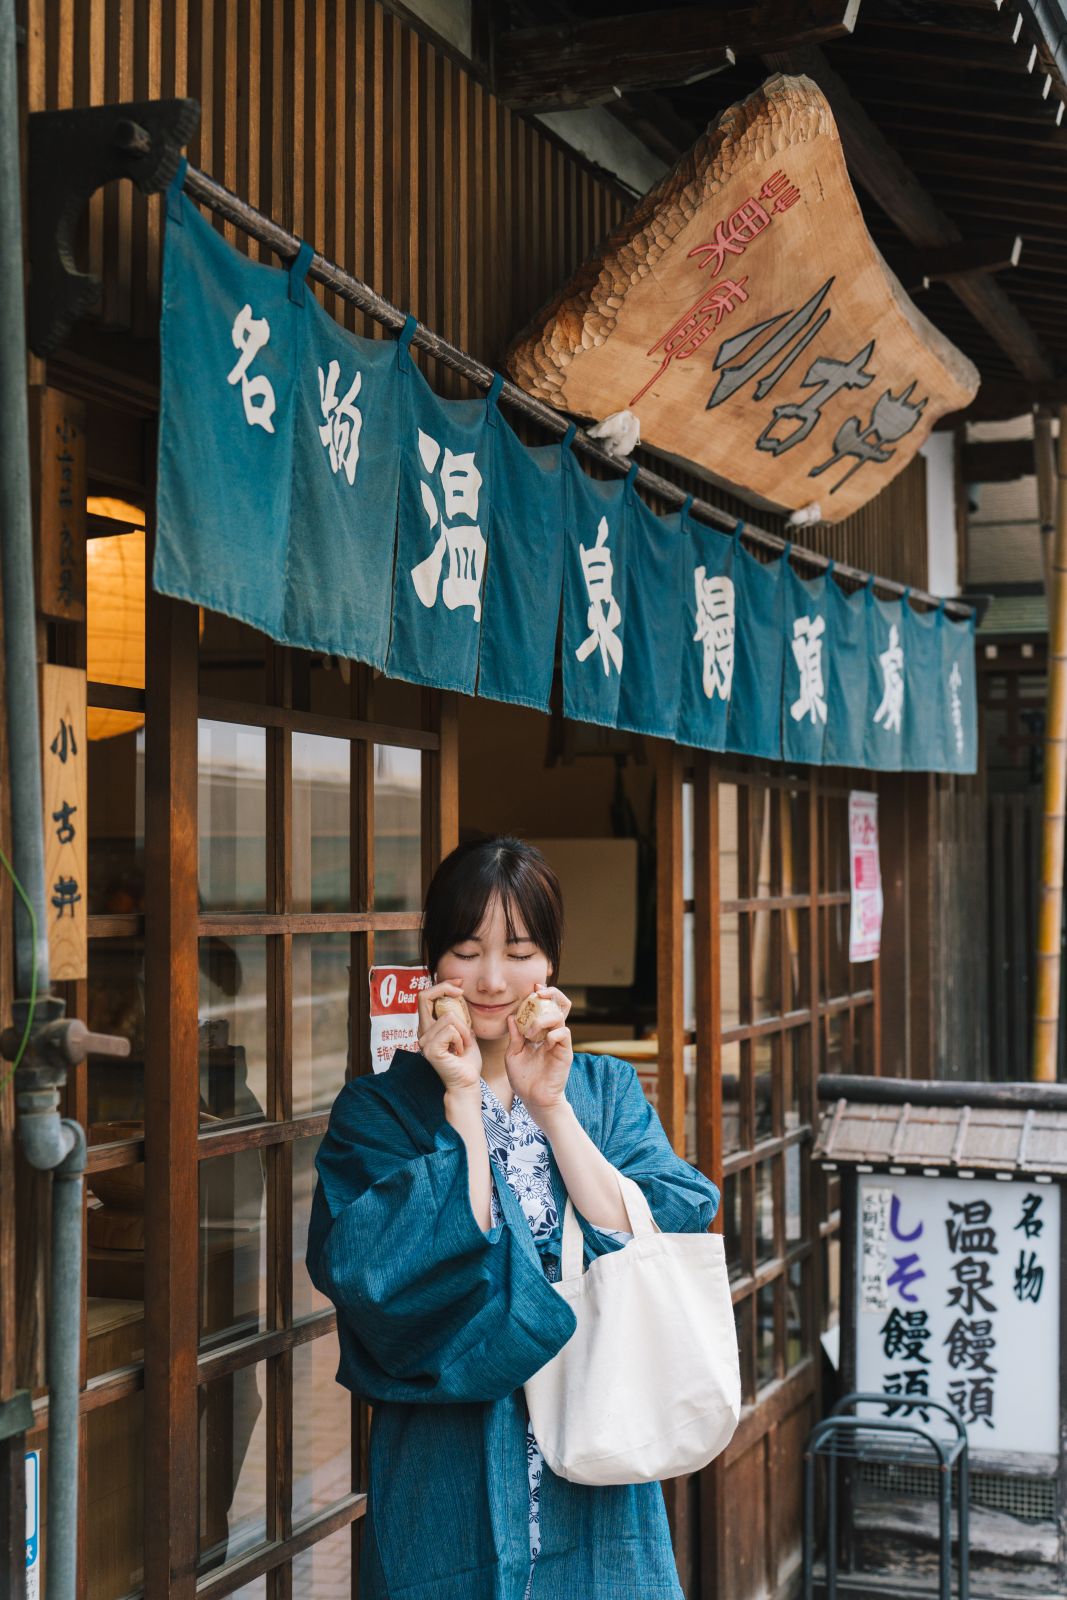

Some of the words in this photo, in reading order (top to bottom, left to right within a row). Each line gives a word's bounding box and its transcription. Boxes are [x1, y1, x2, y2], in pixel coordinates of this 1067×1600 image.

[706, 275, 930, 495] 小古井
[50, 718, 81, 919] 小古井
[397, 990, 417, 1004] Dear
[943, 1200, 998, 1429] 温泉饅頭
[1013, 1193, 1046, 1304] 名物
